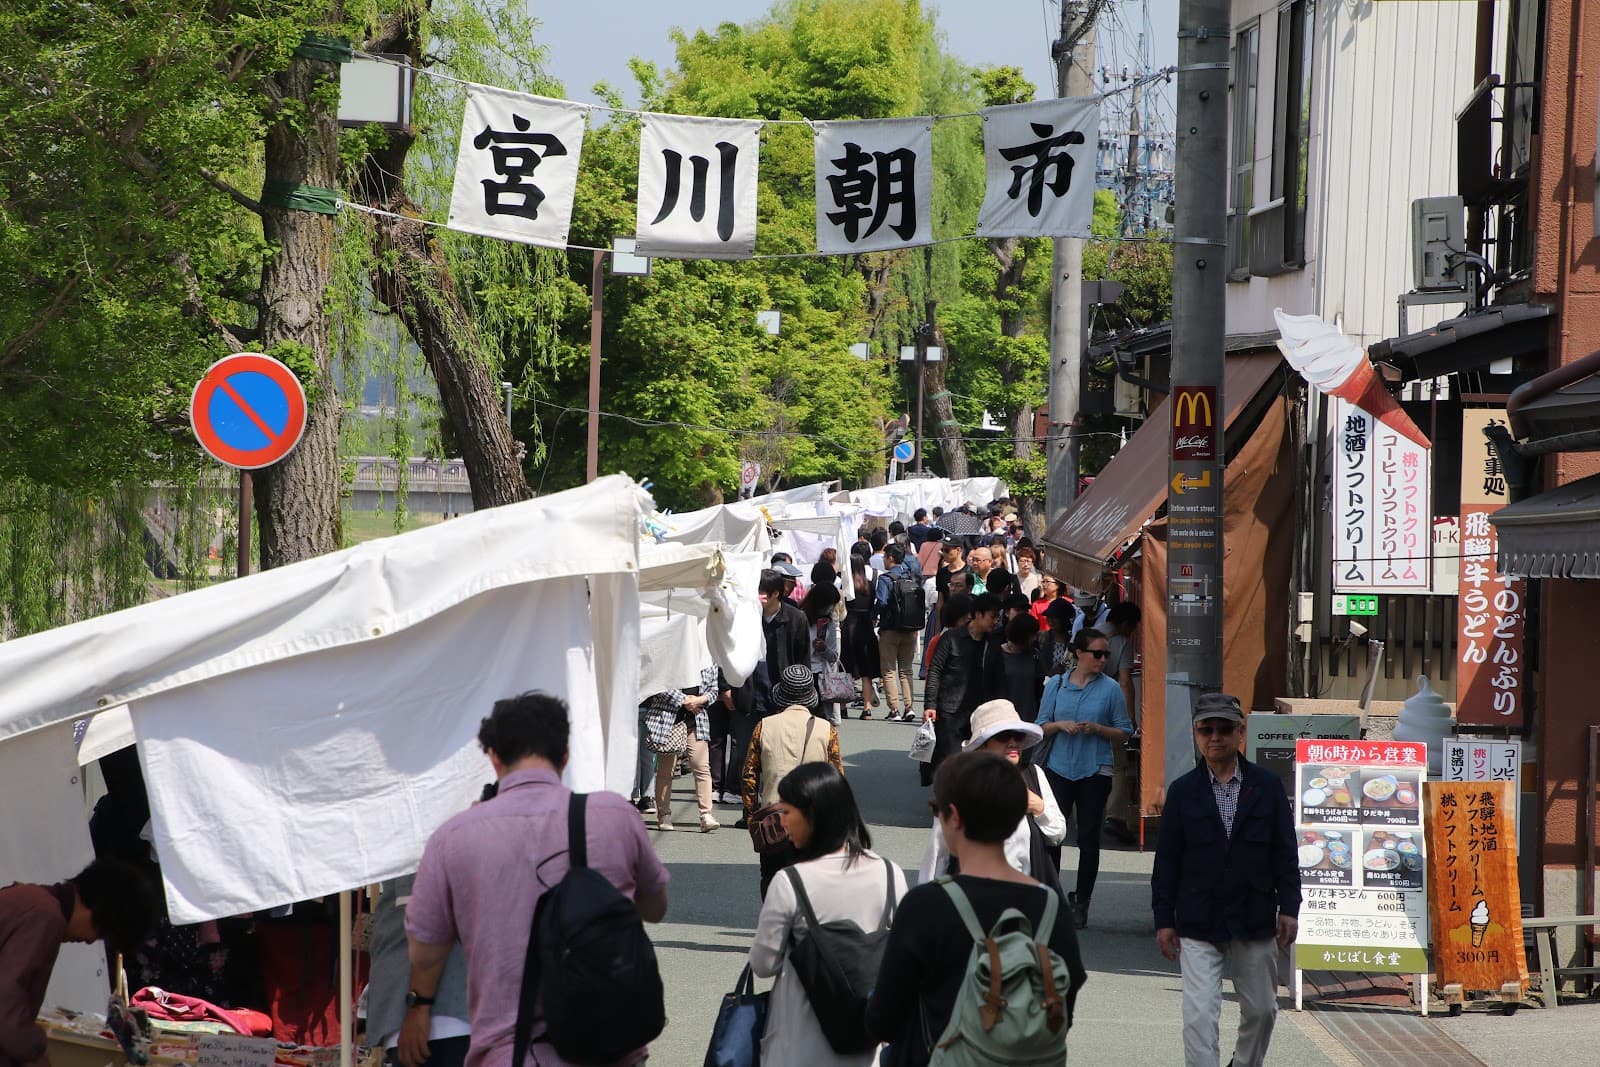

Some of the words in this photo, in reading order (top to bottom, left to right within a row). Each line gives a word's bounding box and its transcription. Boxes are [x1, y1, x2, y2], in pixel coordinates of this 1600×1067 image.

[474, 113, 568, 222] 宮
[650, 141, 739, 242] 川
[825, 141, 918, 244] 朝
[998, 122, 1085, 218] 市
[1344, 415, 1366, 582] 地酒ソフトクリーム
[1381, 434, 1398, 581] コーヒーソフトクリーム
[1402, 451, 1418, 581] 桃ソフトクリーム
[1463, 511, 1490, 664] 飛騨牛うどん
[1257, 732, 1294, 741] COFFEE
[1307, 744, 1418, 763] 朝6時から営業
[1502, 749, 1516, 780] コーヒ
[1479, 792, 1498, 851] 飛騨地酒
[1440, 792, 1462, 913] 桃ソフトクリーム
[1465, 793, 1484, 897] ソフトクリーム
[1307, 900, 1338, 911] 朝定食
[1377, 892, 1405, 902] 600円
[1377, 903, 1406, 912] 600円
[1322, 950, 1401, 966] かじばし食堂
[1456, 950, 1500, 964] 300円
